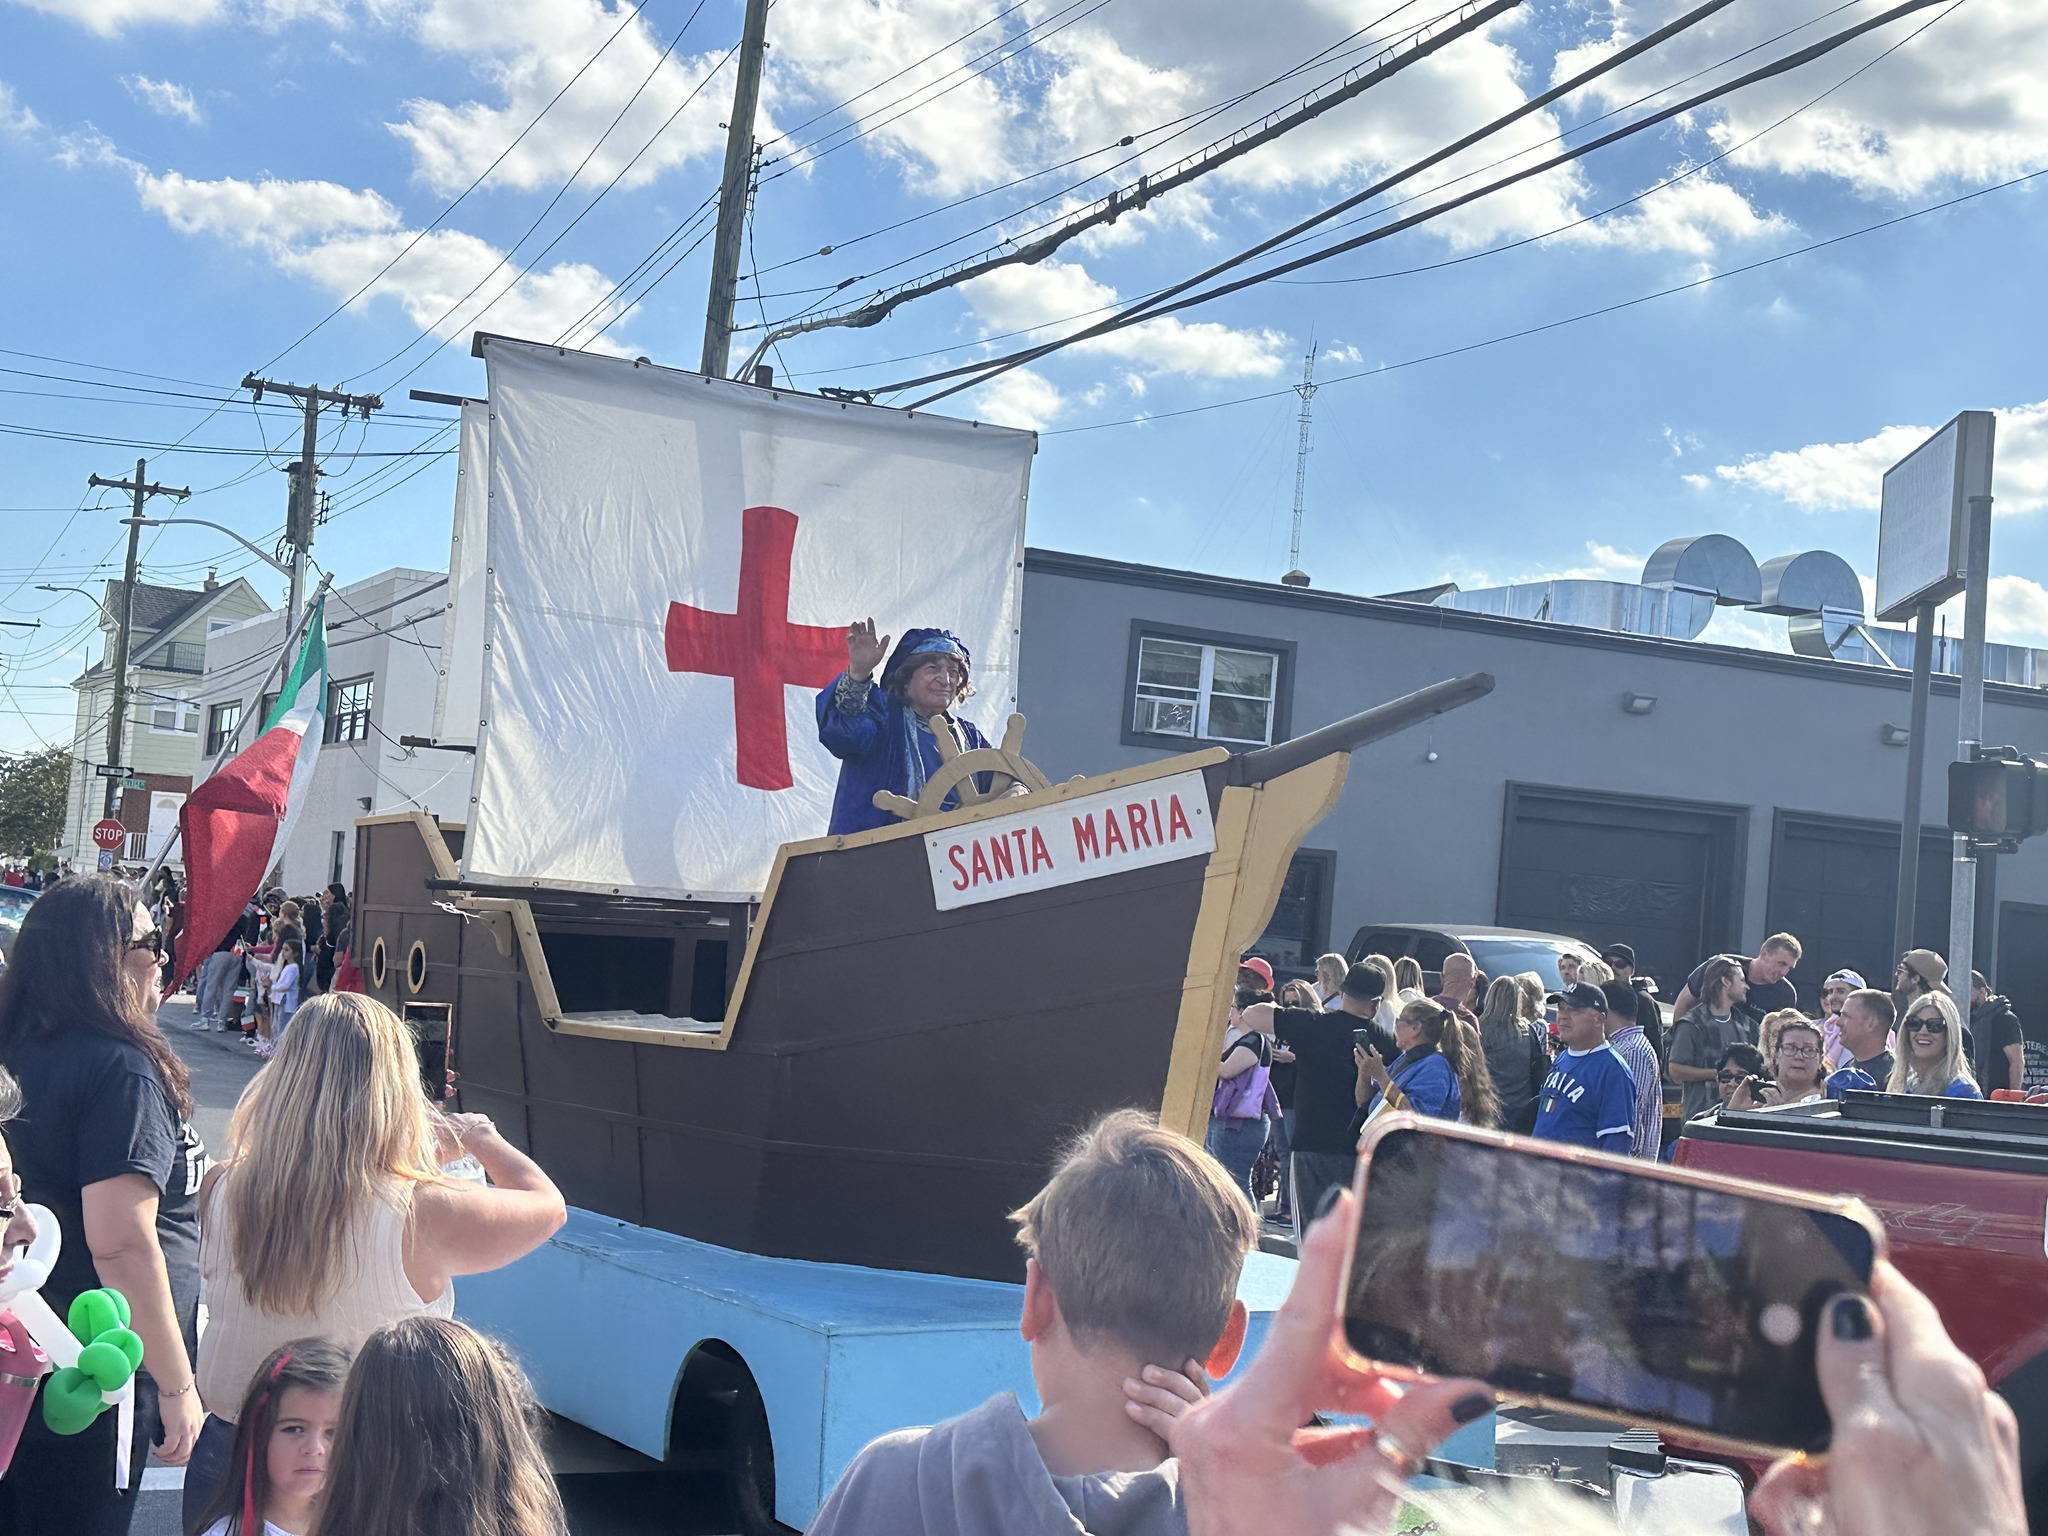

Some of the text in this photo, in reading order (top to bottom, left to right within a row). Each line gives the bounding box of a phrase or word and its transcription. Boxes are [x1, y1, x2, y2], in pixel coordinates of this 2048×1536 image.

[94, 827, 123, 841] STOP
[948, 793, 1193, 891] SANTA MARIA
[1541, 1071, 1585, 1103] TALIA
